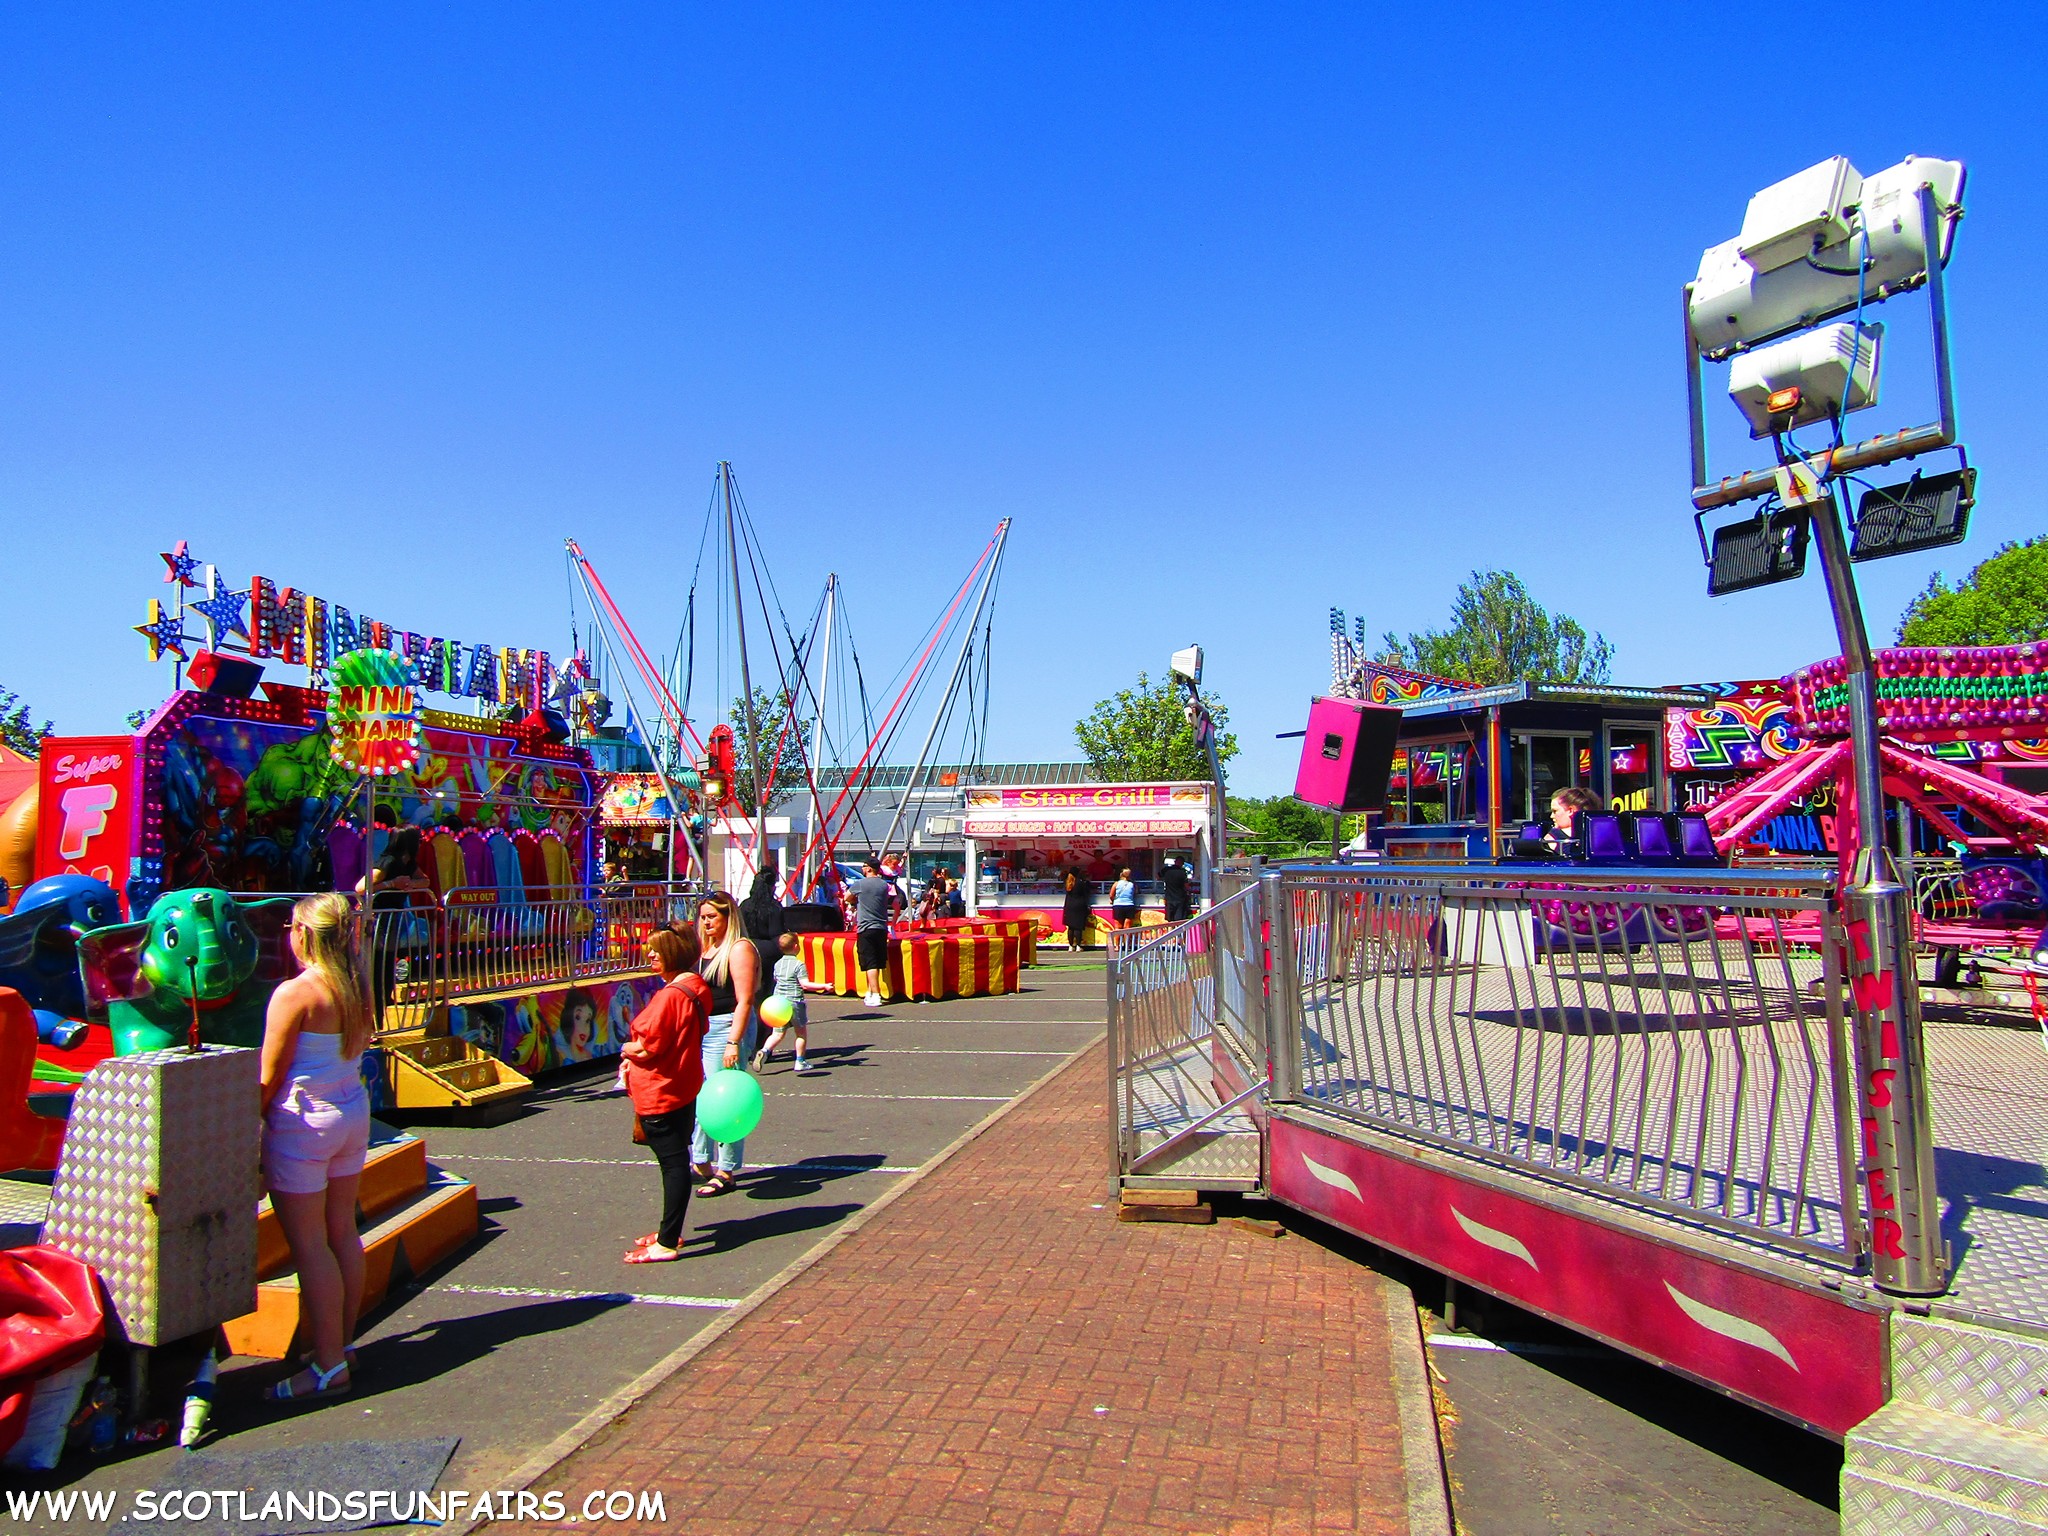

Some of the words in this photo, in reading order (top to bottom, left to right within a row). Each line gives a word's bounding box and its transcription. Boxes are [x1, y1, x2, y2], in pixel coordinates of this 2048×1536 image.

[402, 631, 551, 711] MIAMI
[338, 684, 414, 714] MINI
[338, 718, 415, 742] MIAMI
[54, 754, 123, 783] Super
[1019, 790, 1084, 807] Star
[1092, 788, 1156, 806] Grill
[968, 822, 1006, 833] CHEESE
[1007, 821, 1047, 833] BURGER
[1053, 821, 1074, 832] HOT
[1075, 821, 1097, 832] DOG
[1103, 821, 1148, 832] CHICKEN
[1149, 821, 1191, 832] BURGER
[461, 892, 479, 902] WAY
[479, 892, 496, 901] OUT
[1845, 918, 1908, 1262] TWISTER
